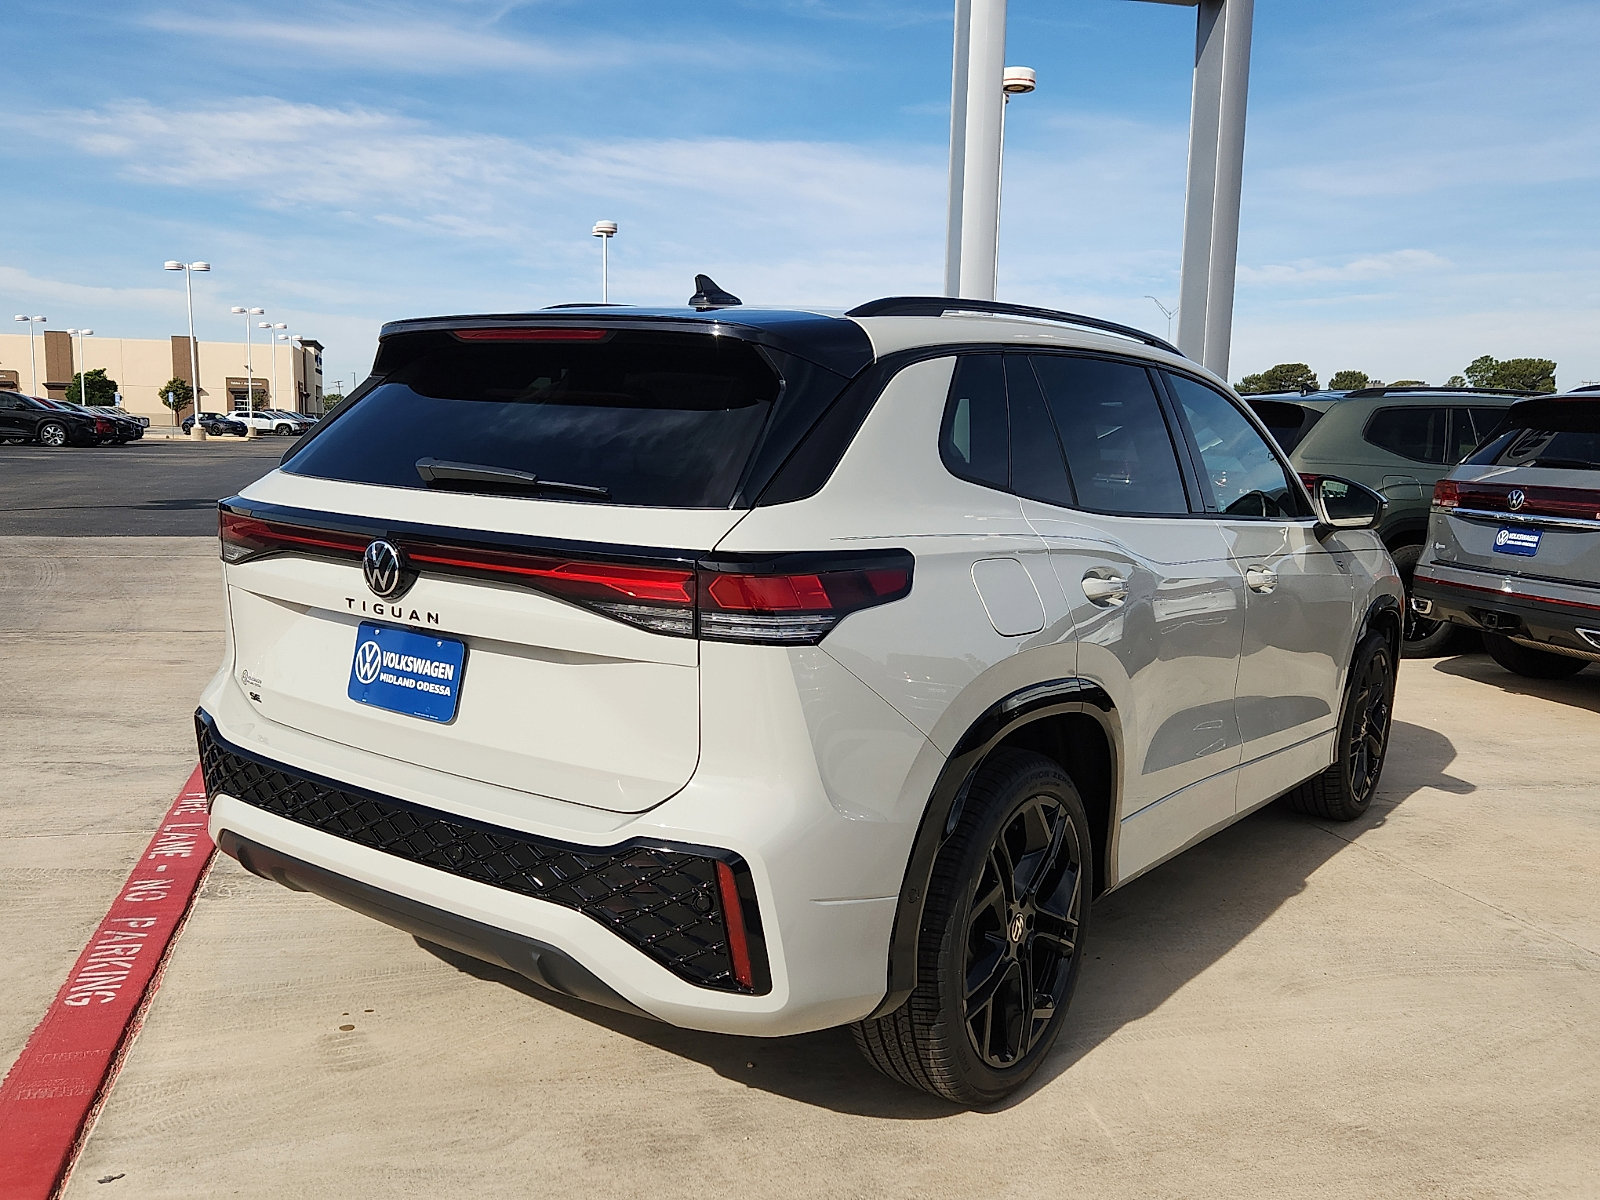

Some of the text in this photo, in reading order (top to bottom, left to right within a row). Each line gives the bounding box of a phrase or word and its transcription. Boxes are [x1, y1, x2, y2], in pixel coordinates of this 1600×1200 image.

[345, 597, 440, 624] TIGUAN
[382, 650, 455, 681] VOLKSWAGEN
[379, 672, 451, 697] MIDLAND ODESSA
[173, 792, 208, 816] FIRE
[148, 823, 204, 860] LANE
[123, 879, 175, 902] NO
[64, 917, 158, 1006] PARKING
